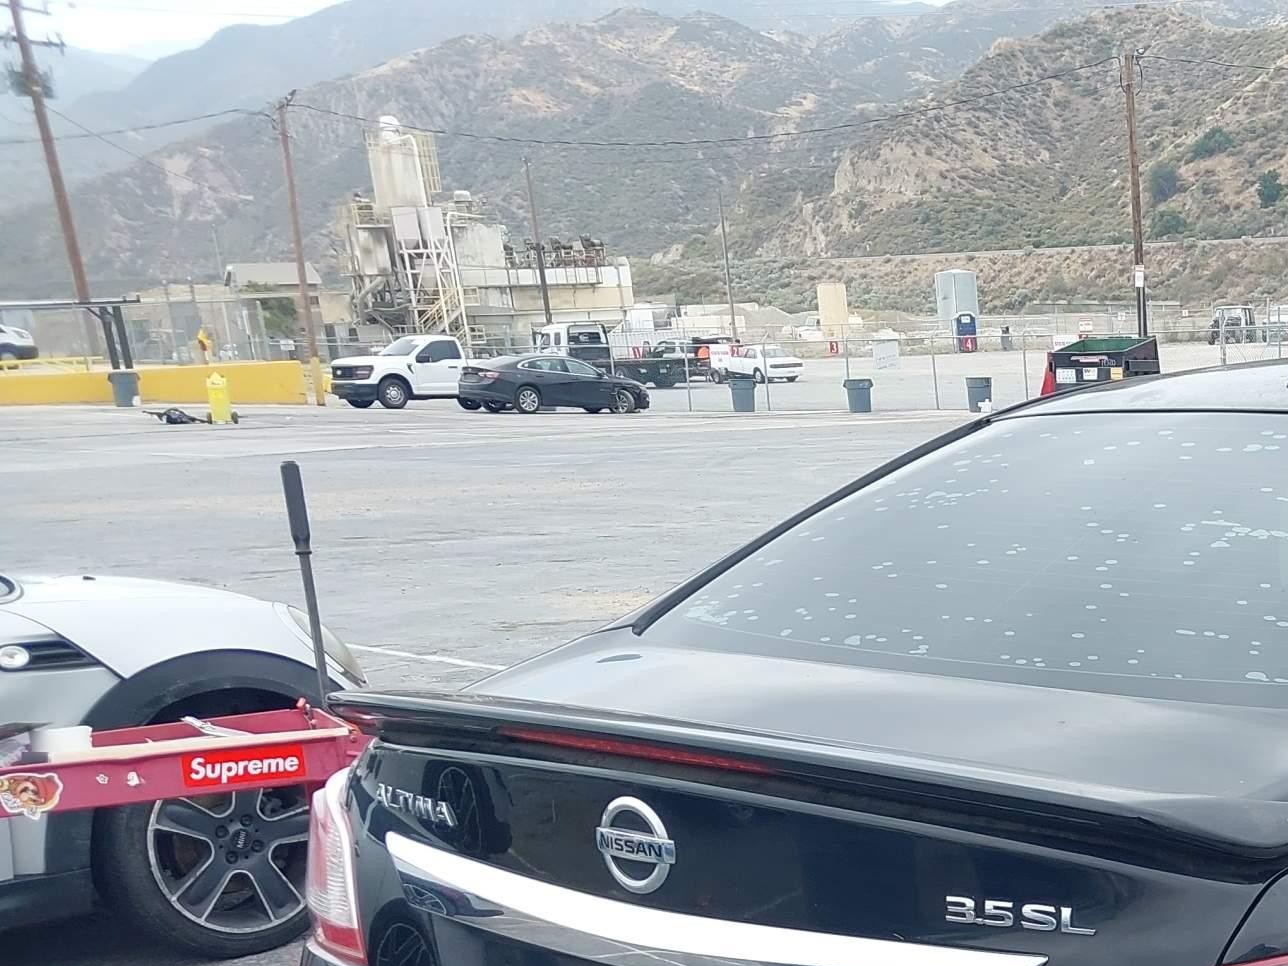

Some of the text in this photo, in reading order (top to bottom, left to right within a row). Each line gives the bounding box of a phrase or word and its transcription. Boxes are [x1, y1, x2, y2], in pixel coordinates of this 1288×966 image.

[831, 342, 838, 353] 3
[966, 339, 972, 352] 4
[190, 756, 299, 784] Supreme
[376, 783, 458, 826] ALTIMA
[600, 831, 662, 858] NISSAN
[1020, 903, 1096, 936] SL
